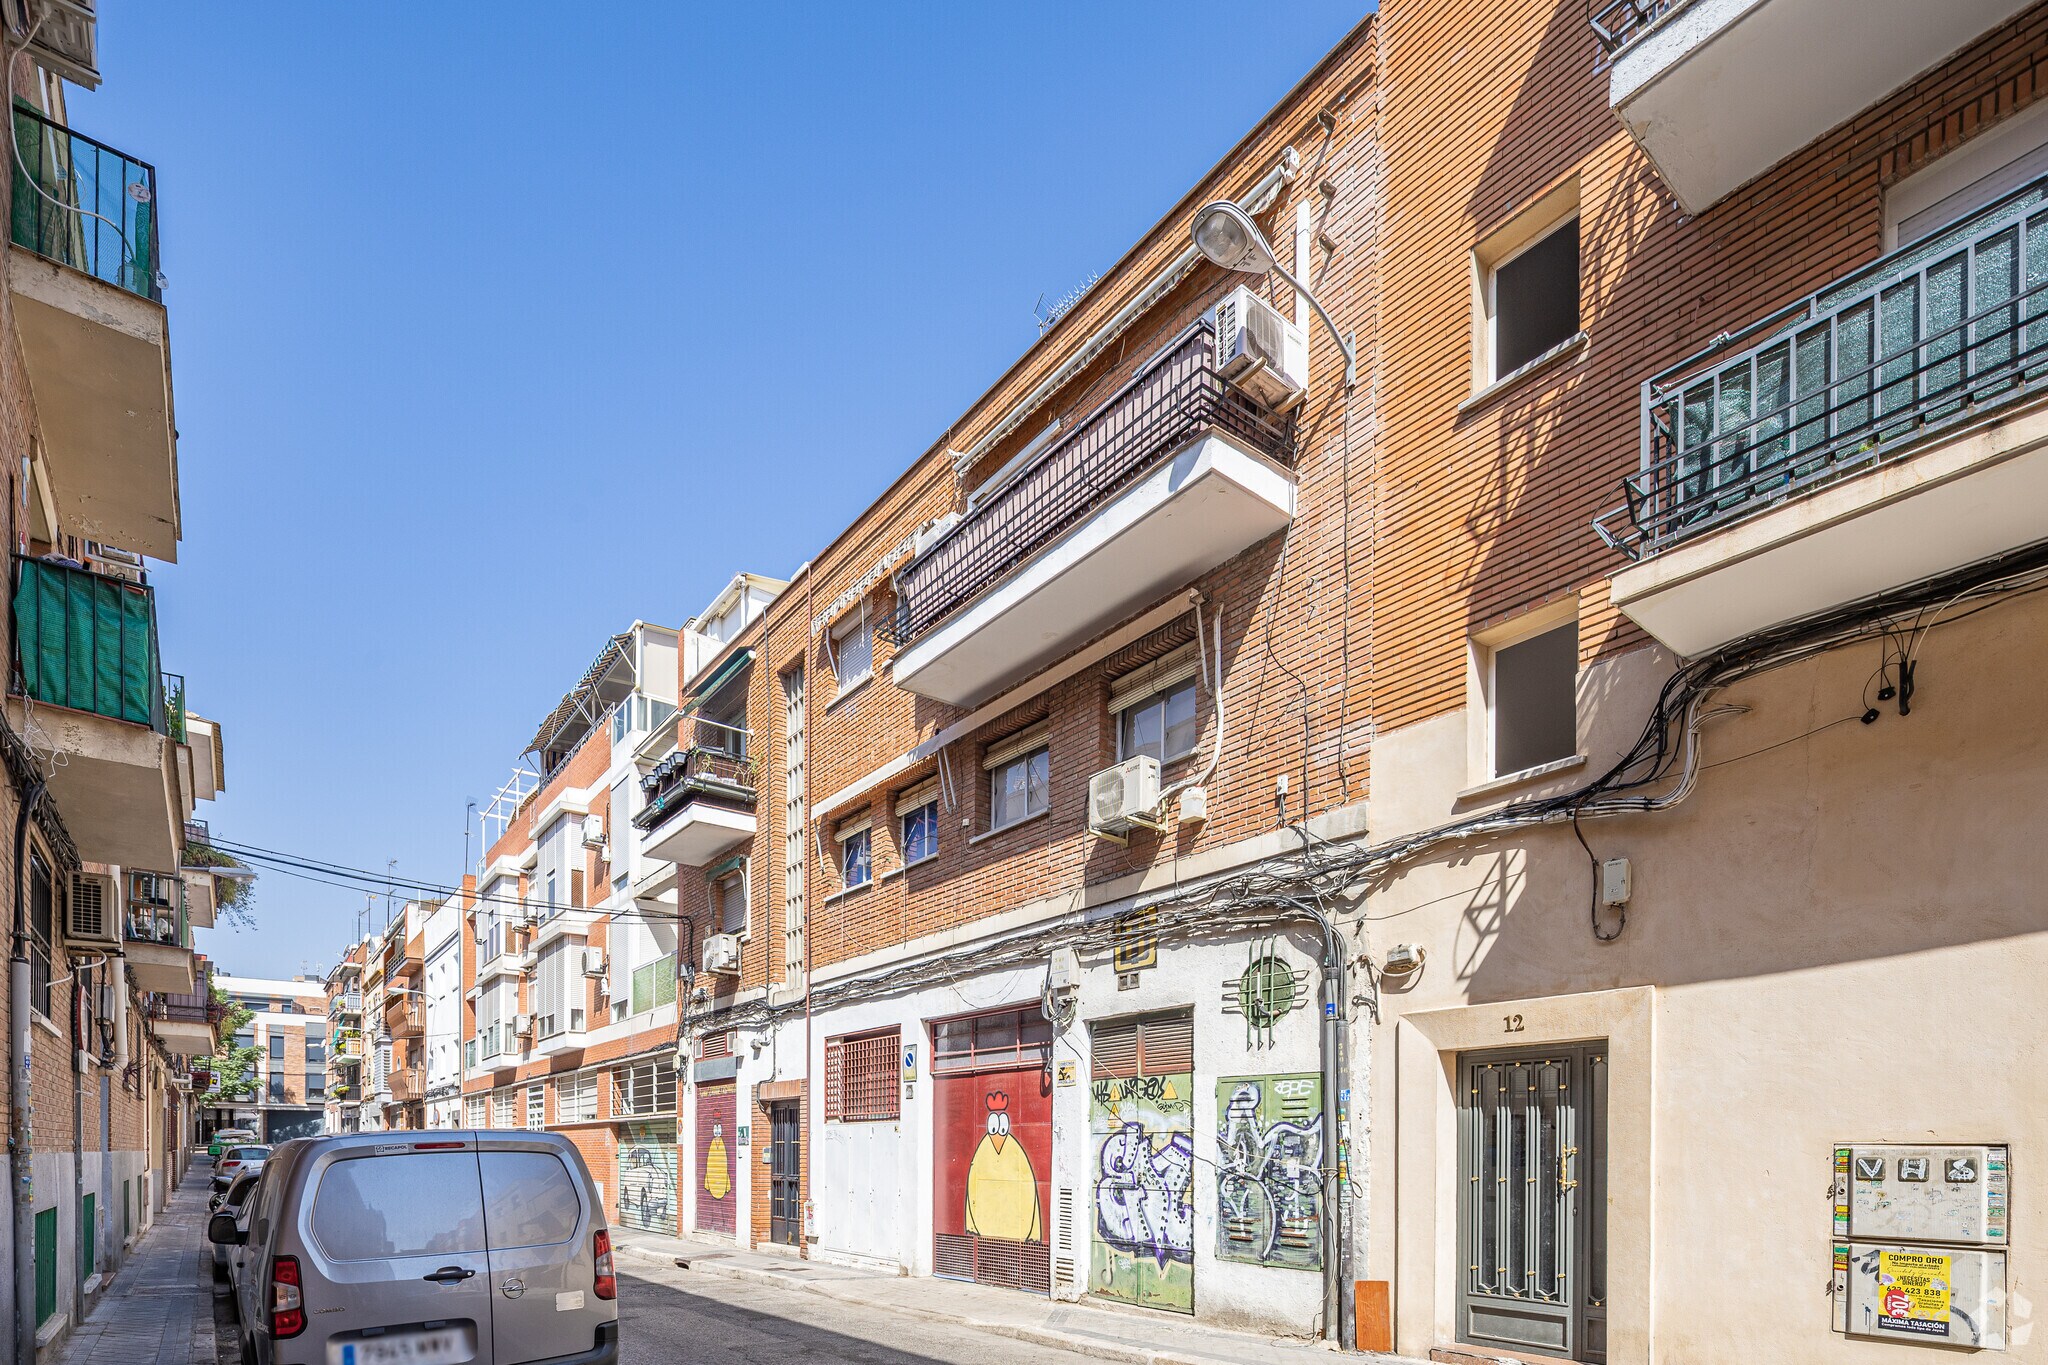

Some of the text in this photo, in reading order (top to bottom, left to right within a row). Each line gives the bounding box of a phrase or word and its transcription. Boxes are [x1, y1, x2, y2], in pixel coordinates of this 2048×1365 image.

[1503, 1014, 1524, 1032] 12
[1889, 1254, 1922, 1262] COMPRO
[1891, 1294, 1910, 1318] 70€
[1910, 1321, 1945, 1329] TASACIÓN
